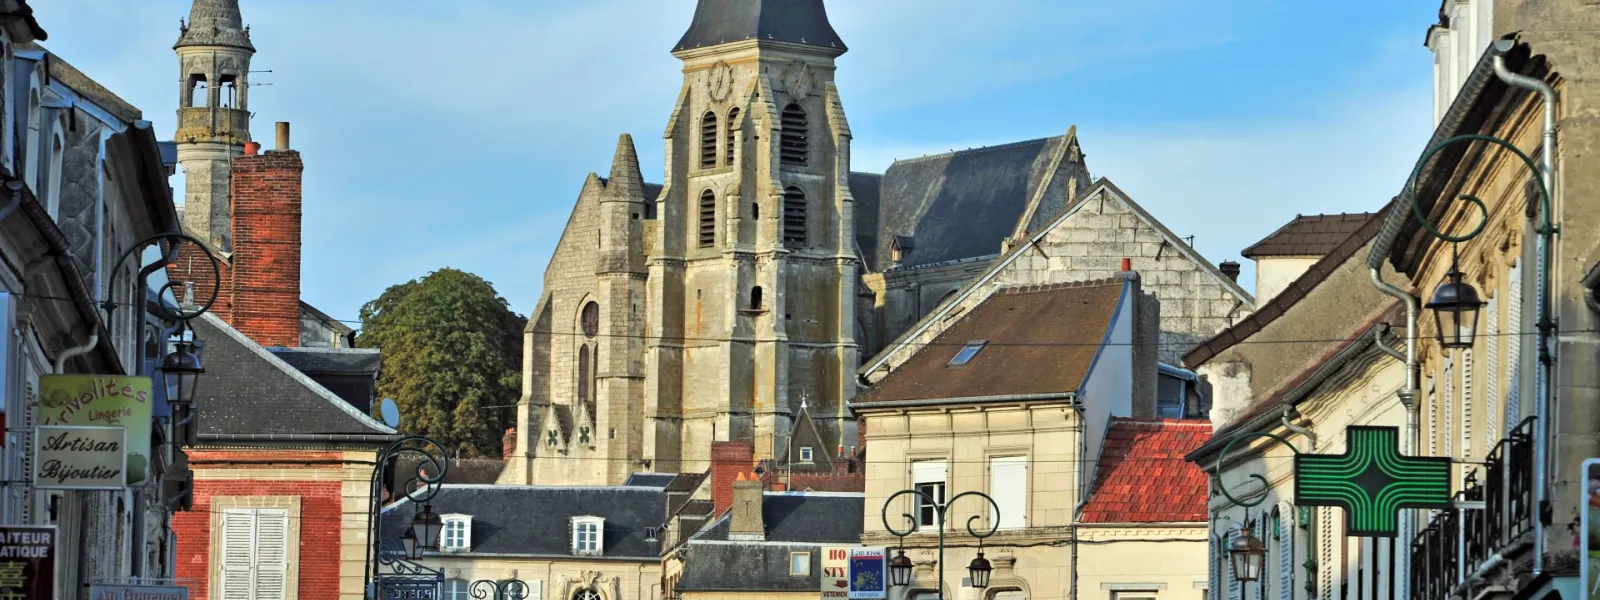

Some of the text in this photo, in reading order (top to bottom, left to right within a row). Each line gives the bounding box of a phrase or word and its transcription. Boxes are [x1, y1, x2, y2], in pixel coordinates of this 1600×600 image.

[88, 407, 133, 421] Lingerie
[42, 432, 120, 452] Artisan
[38, 459, 121, 484] Bijoutier
[0, 545, 49, 558] ATIQUE
[824, 567, 846, 577] STY
